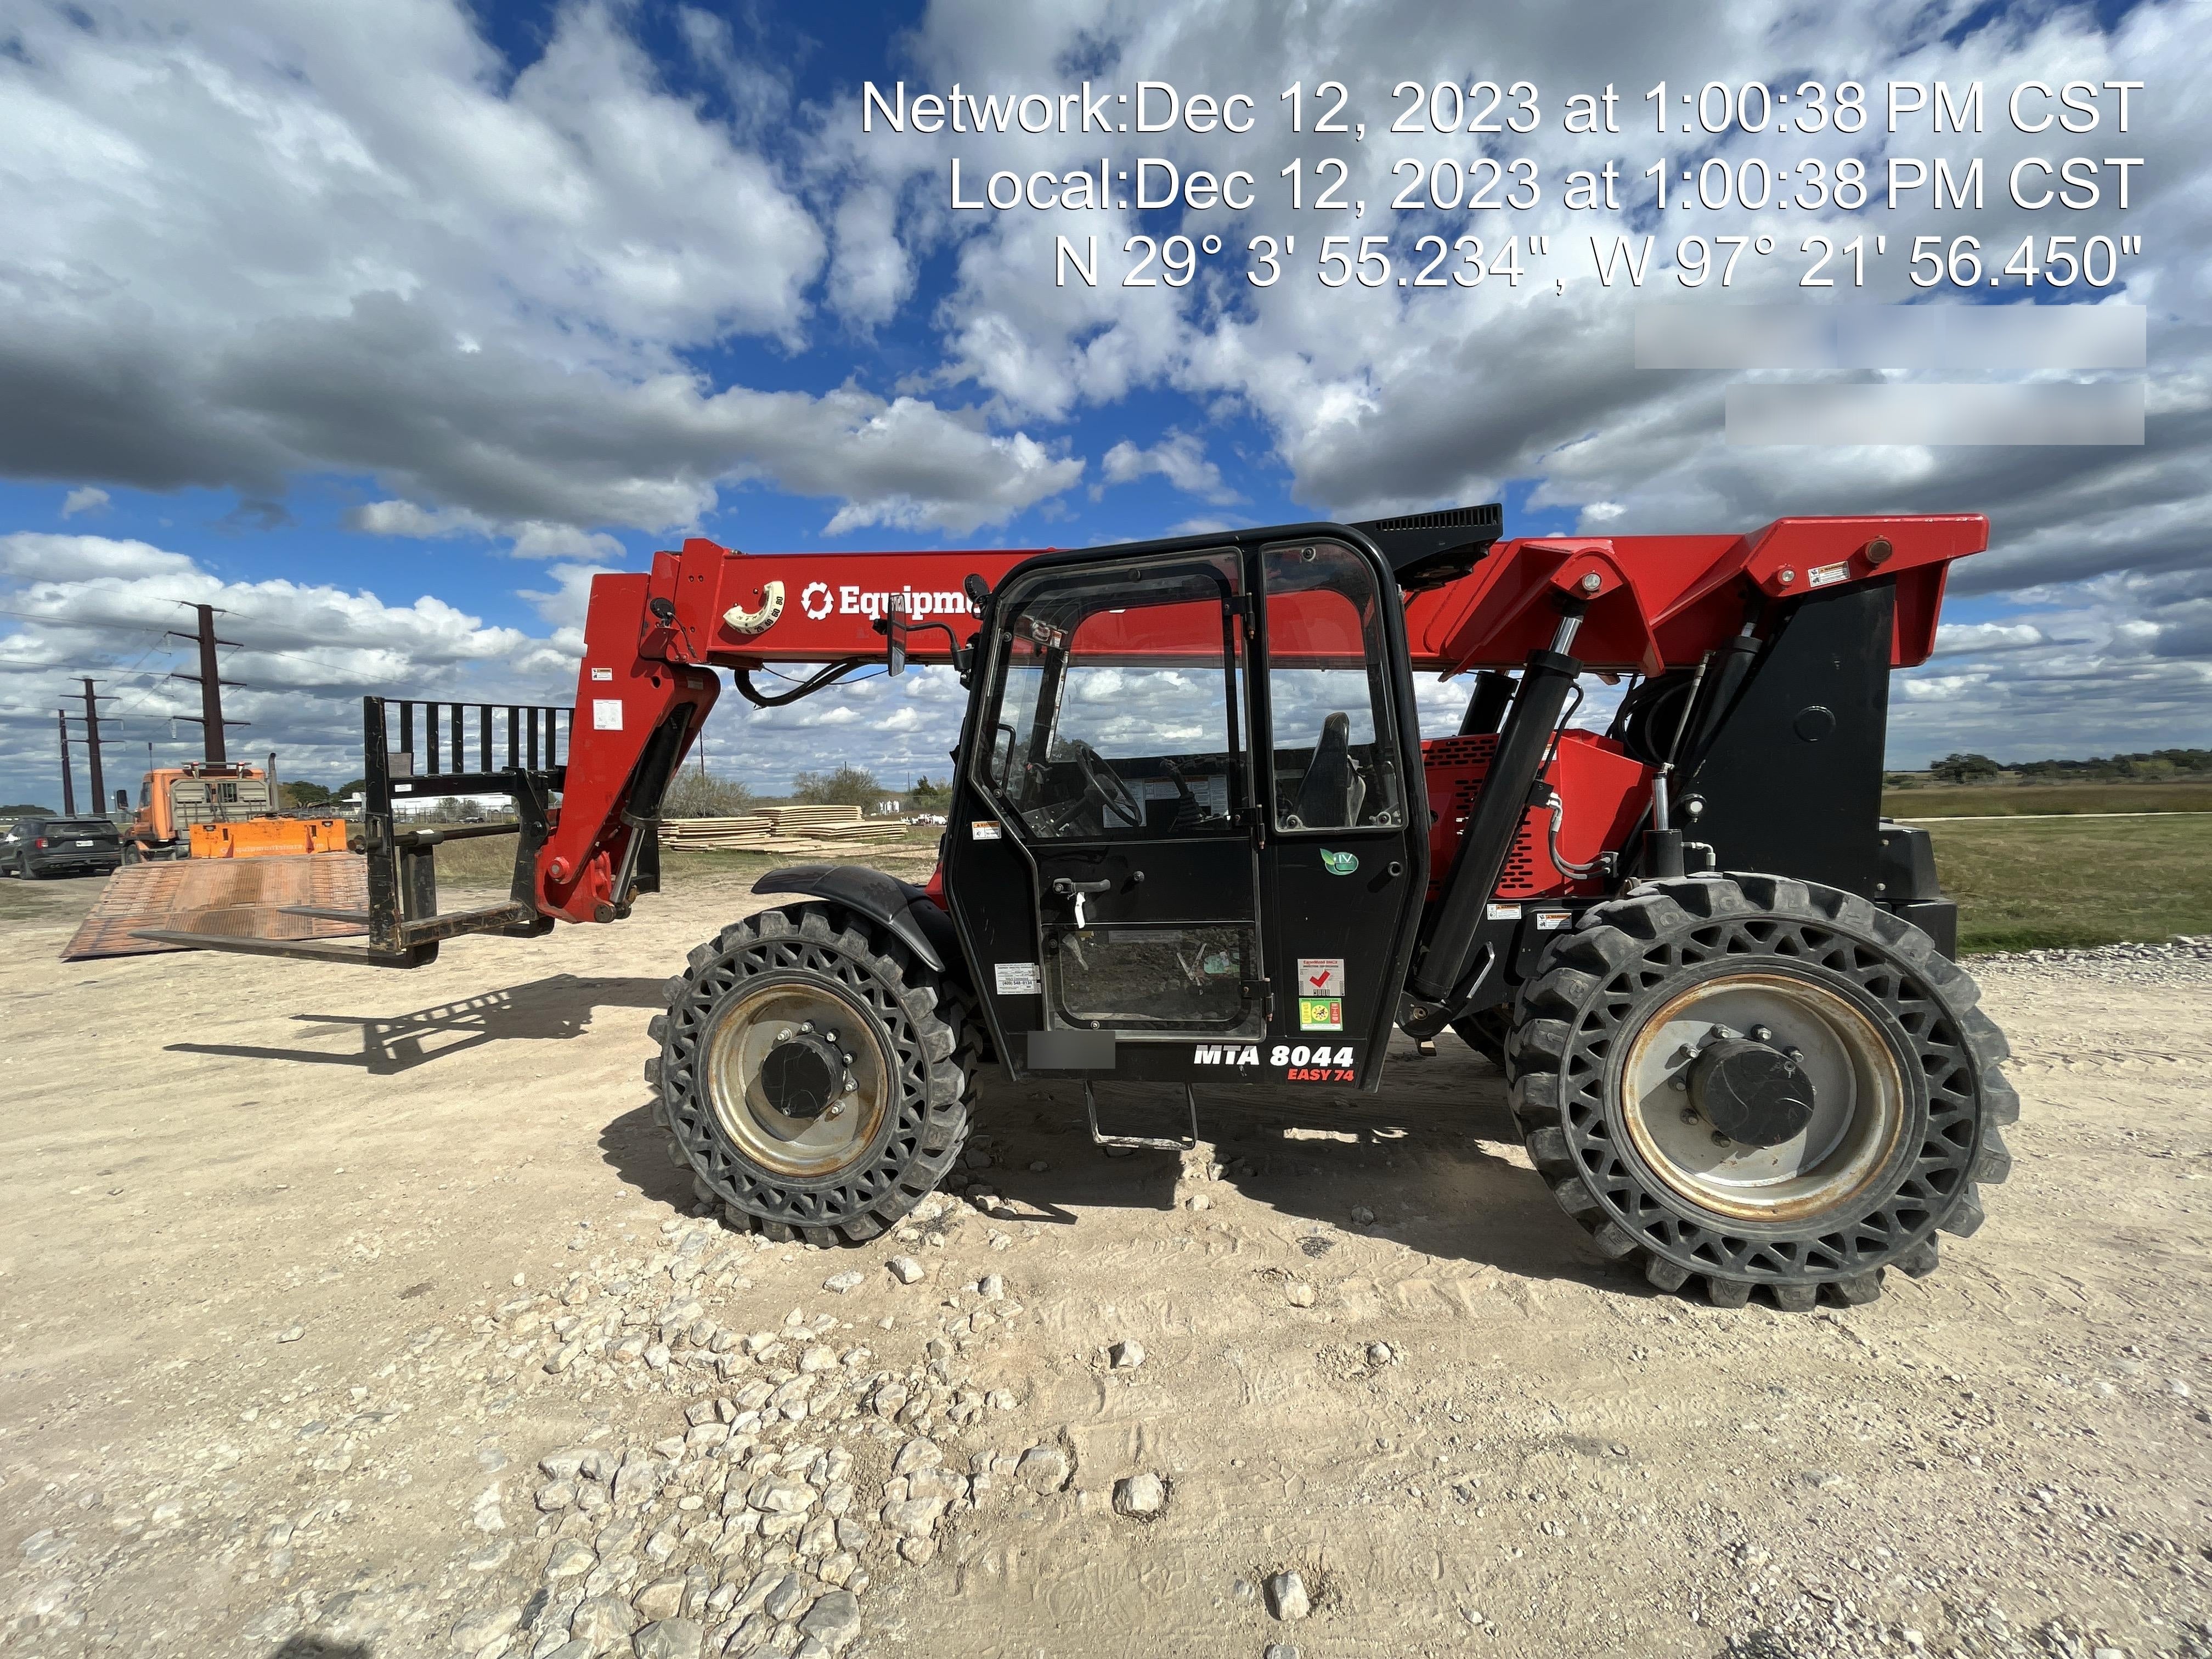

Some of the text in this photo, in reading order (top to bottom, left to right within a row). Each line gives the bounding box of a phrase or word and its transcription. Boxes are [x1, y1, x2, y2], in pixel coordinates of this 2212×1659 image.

[776, 596, 783, 605] 80
[771, 608, 780, 618] 60
[764, 618, 774, 627] 40
[1193, 1044, 1353, 1067] MTA 8044
[1287, 1068, 1355, 1081] EASY 74
